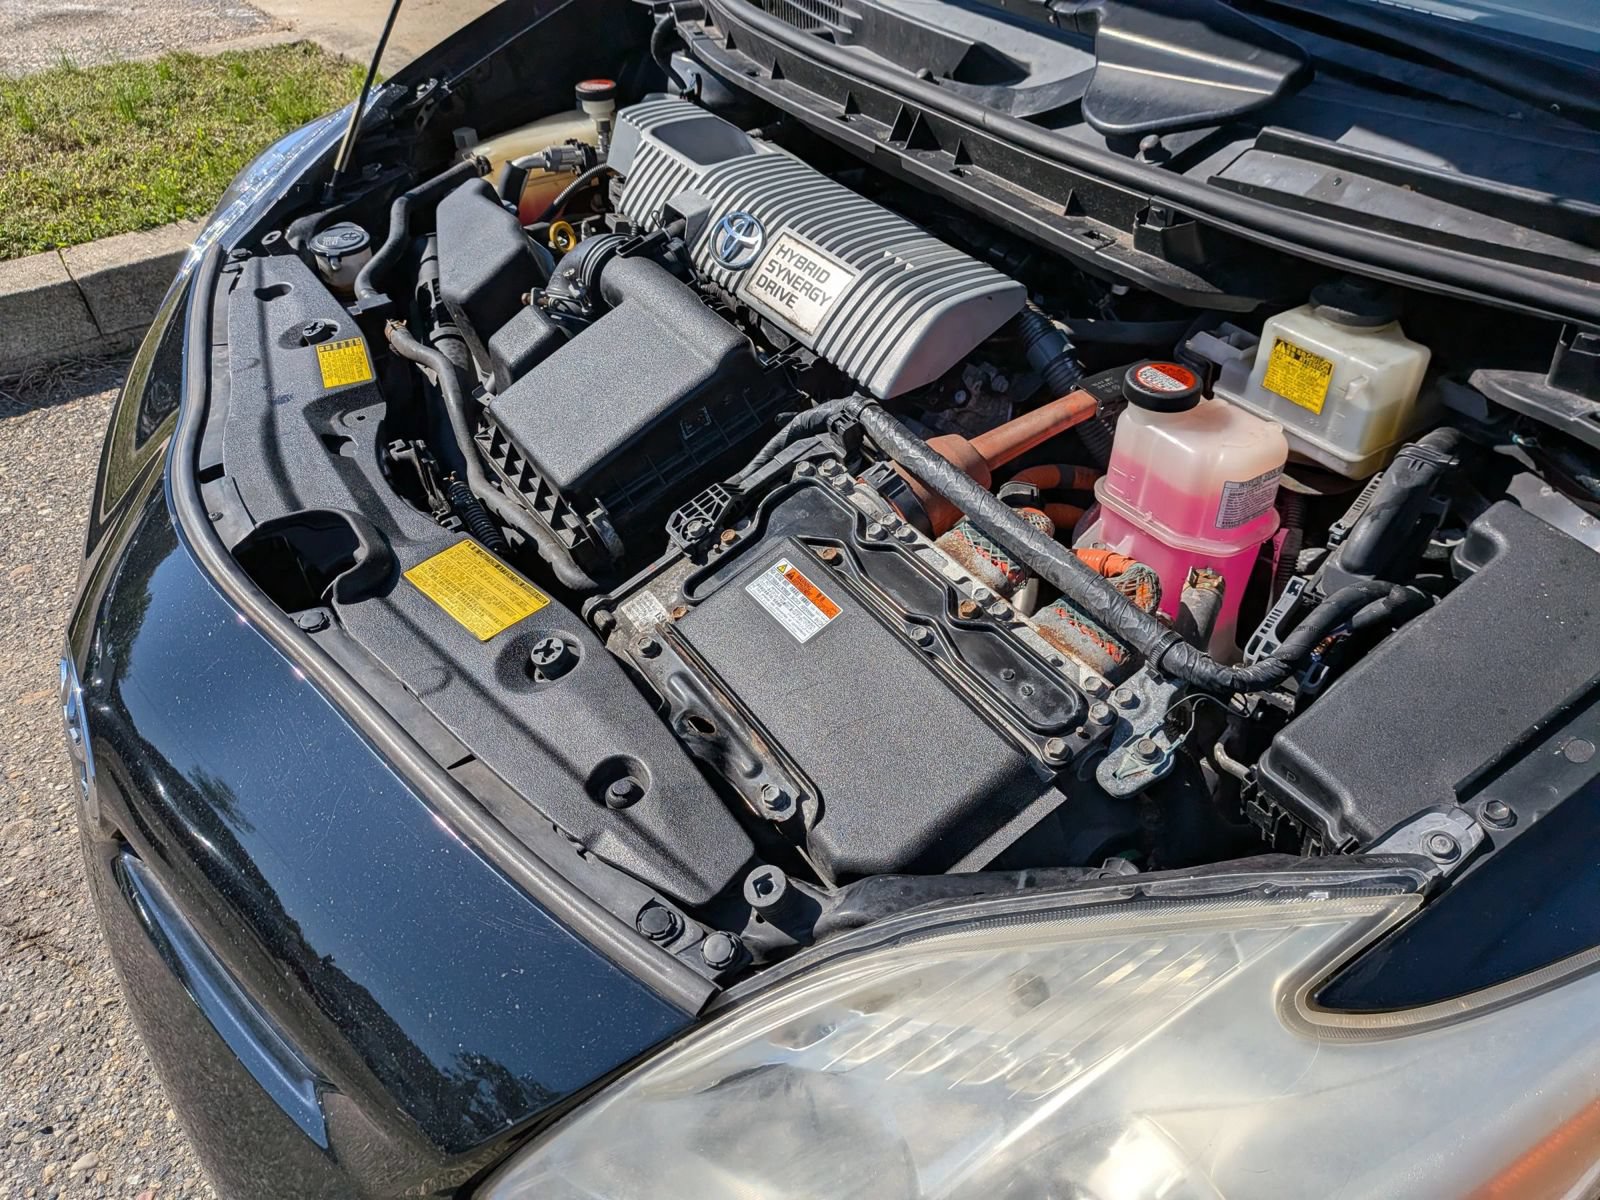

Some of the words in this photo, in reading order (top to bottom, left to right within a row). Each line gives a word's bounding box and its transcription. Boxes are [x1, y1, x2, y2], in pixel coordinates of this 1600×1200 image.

[765, 259, 832, 306] SYNERGY
[776, 244, 831, 284] HYBRID
[755, 274, 799, 309] DRIVE
